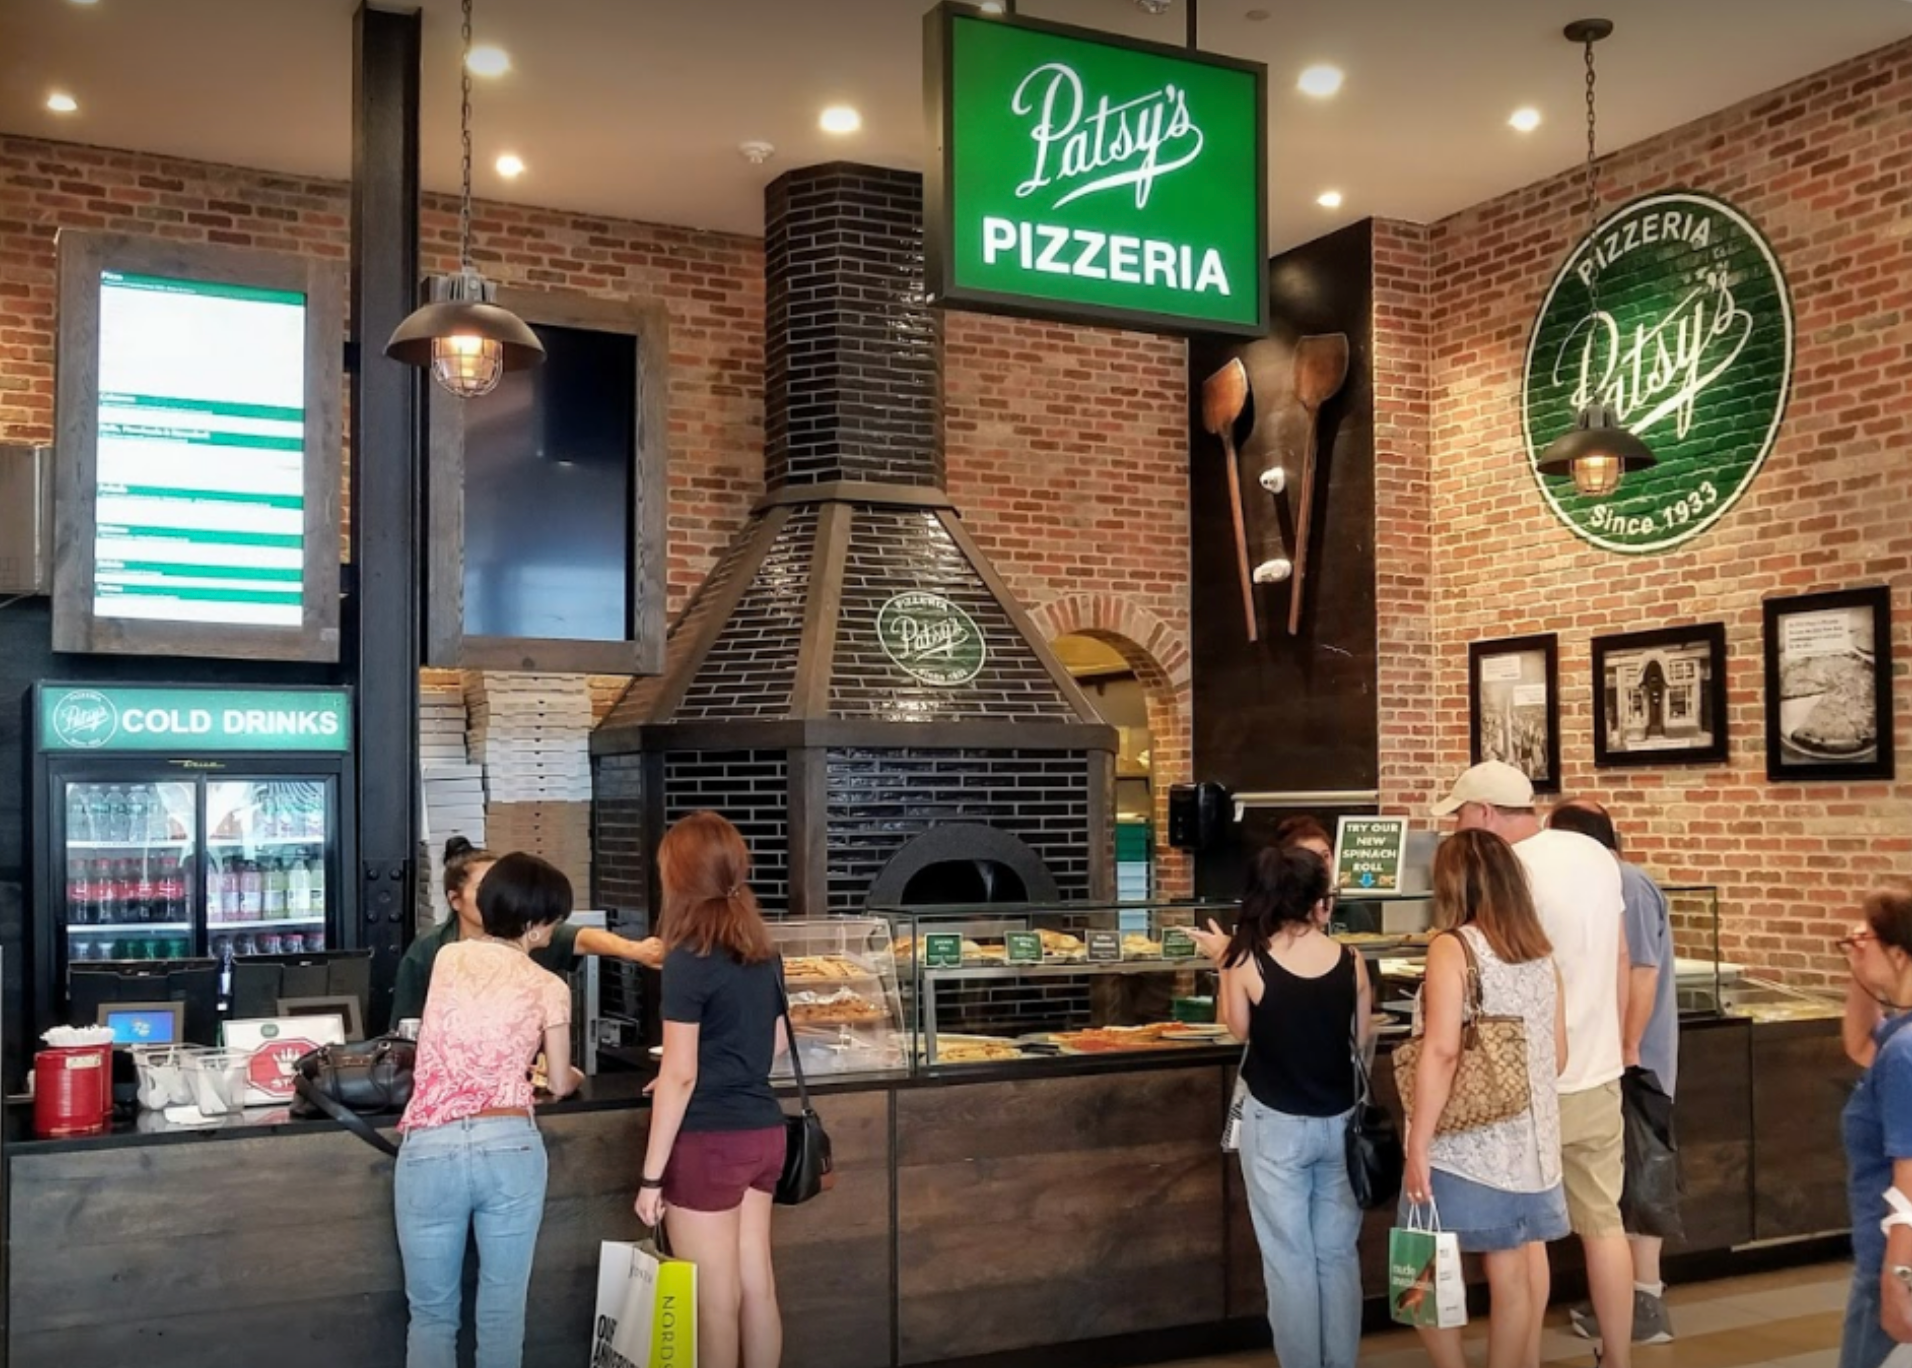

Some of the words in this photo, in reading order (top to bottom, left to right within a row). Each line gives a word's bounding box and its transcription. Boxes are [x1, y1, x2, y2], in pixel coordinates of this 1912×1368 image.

[1011, 62, 1204, 210] Patsy's
[982, 216, 1231, 296] PIZZERIA
[1577, 211, 1712, 286] PIZZERIA
[1590, 504, 1654, 535] Since
[1662, 481, 1718, 529] 1933
[890, 615, 970, 662] Patsy's
[122, 708, 211, 734] COLD
[223, 710, 339, 735] DRINKS
[1346, 823, 1369, 833] TRY
[1370, 823, 1399, 832] OUR
[1356, 837, 1387, 846] NEW
[1342, 849, 1397, 859] SPINACH
[1352, 862, 1384, 872] ROLL
